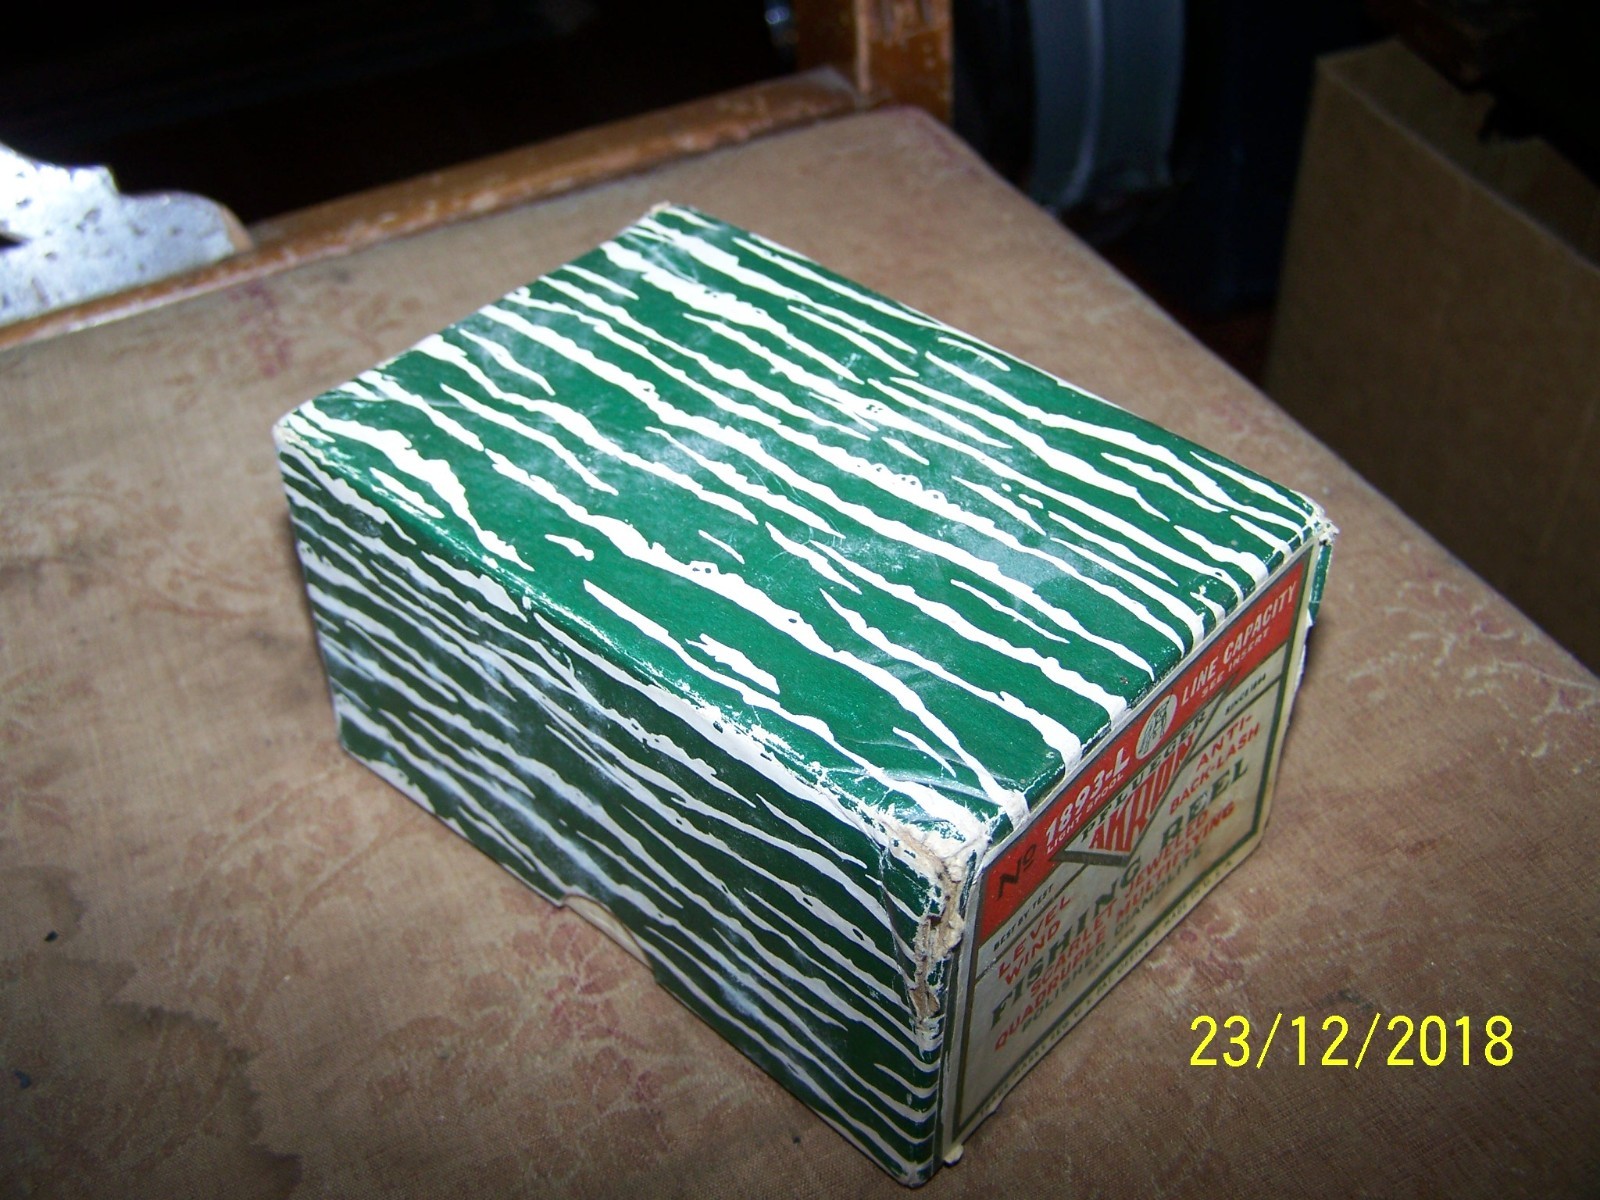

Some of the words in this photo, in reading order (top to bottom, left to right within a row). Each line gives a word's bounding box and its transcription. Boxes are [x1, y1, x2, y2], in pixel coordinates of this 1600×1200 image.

[1181, 655, 1218, 706] LINE
[1223, 579, 1296, 666] CAPACITY
[1202, 669, 1224, 698] SEE
[1228, 624, 1270, 672] INSERT
[1081, 708, 1205, 842] PFLUEGER
[1088, 731, 1193, 851] AKRON
[1169, 719, 1260, 816] BACK-LASH
[1195, 715, 1252, 771] ANTI-
[1046, 745, 1129, 846] 1893-L
[1047, 811, 1081, 854] LIGHT
[1086, 770, 1123, 814] SPOOL
[991, 852, 1141, 1029] FISHING
[1160, 754, 1248, 850] REEL
[993, 923, 1015, 952] BEST
[1018, 908, 1028, 926] BY
[1032, 882, 1053, 910] TEST
[995, 924, 1105, 1050] QUADRUPLE
[1116, 796, 1236, 923] MULTIPLYING
[998, 890, 1070, 978] LEVEL
[1030, 897, 1117, 998] SCARLET
[1124, 805, 1209, 899] JEWELED
[1005, 916, 1060, 984] WIND
[1021, 939, 1105, 1033] POLISHED
